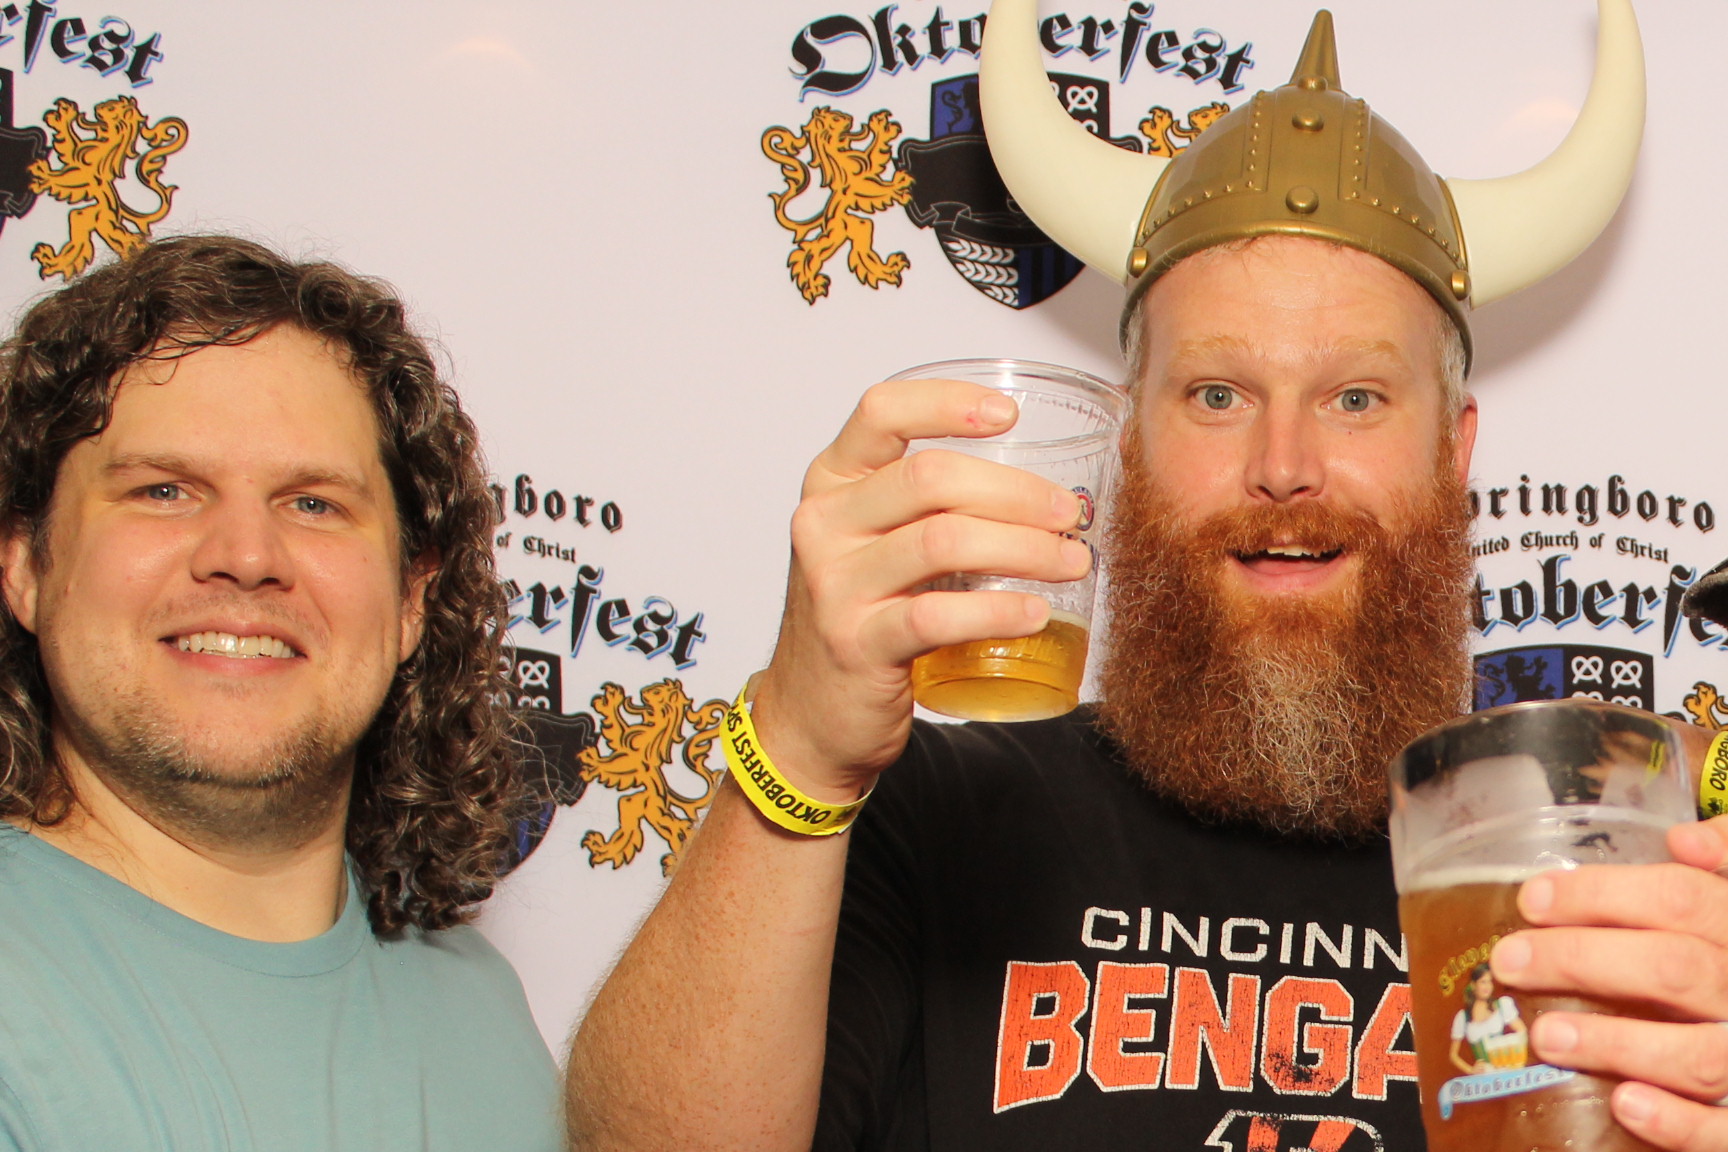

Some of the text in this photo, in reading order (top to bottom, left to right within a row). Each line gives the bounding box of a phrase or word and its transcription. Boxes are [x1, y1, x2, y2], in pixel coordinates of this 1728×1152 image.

[788, 2, 1254, 102] Oktoerfest
[522, 535, 577, 564] Christ
[1519, 530, 1579, 553] Church
[1589, 532, 1604, 550] of
[1615, 535, 1669, 564] Christ
[731, 731, 832, 825] OKTOBERFEST
